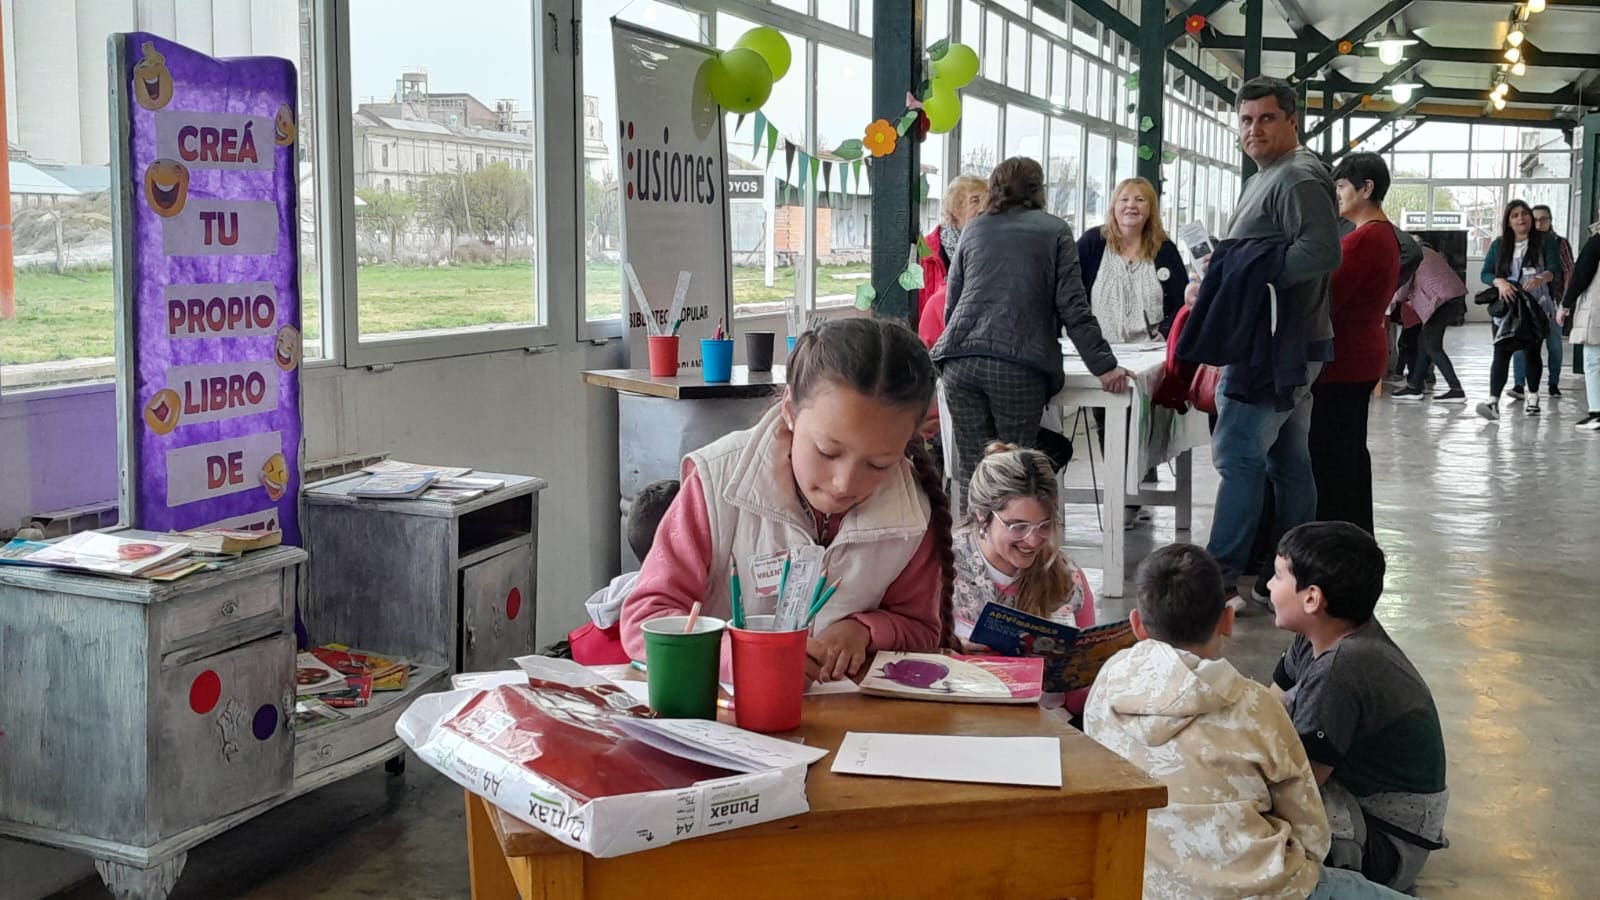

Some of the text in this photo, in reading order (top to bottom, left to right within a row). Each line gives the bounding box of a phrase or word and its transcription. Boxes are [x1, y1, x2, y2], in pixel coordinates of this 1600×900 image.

[177, 120, 258, 163] CREÁ
[199, 211, 239, 246] TU
[168, 294, 276, 335] PROPIO
[681, 305, 709, 322] OPULAR
[183, 370, 266, 415] LIBRO
[206, 450, 244, 490] DE
[710, 799, 760, 820] Punax
[676, 822, 694, 836] A4
